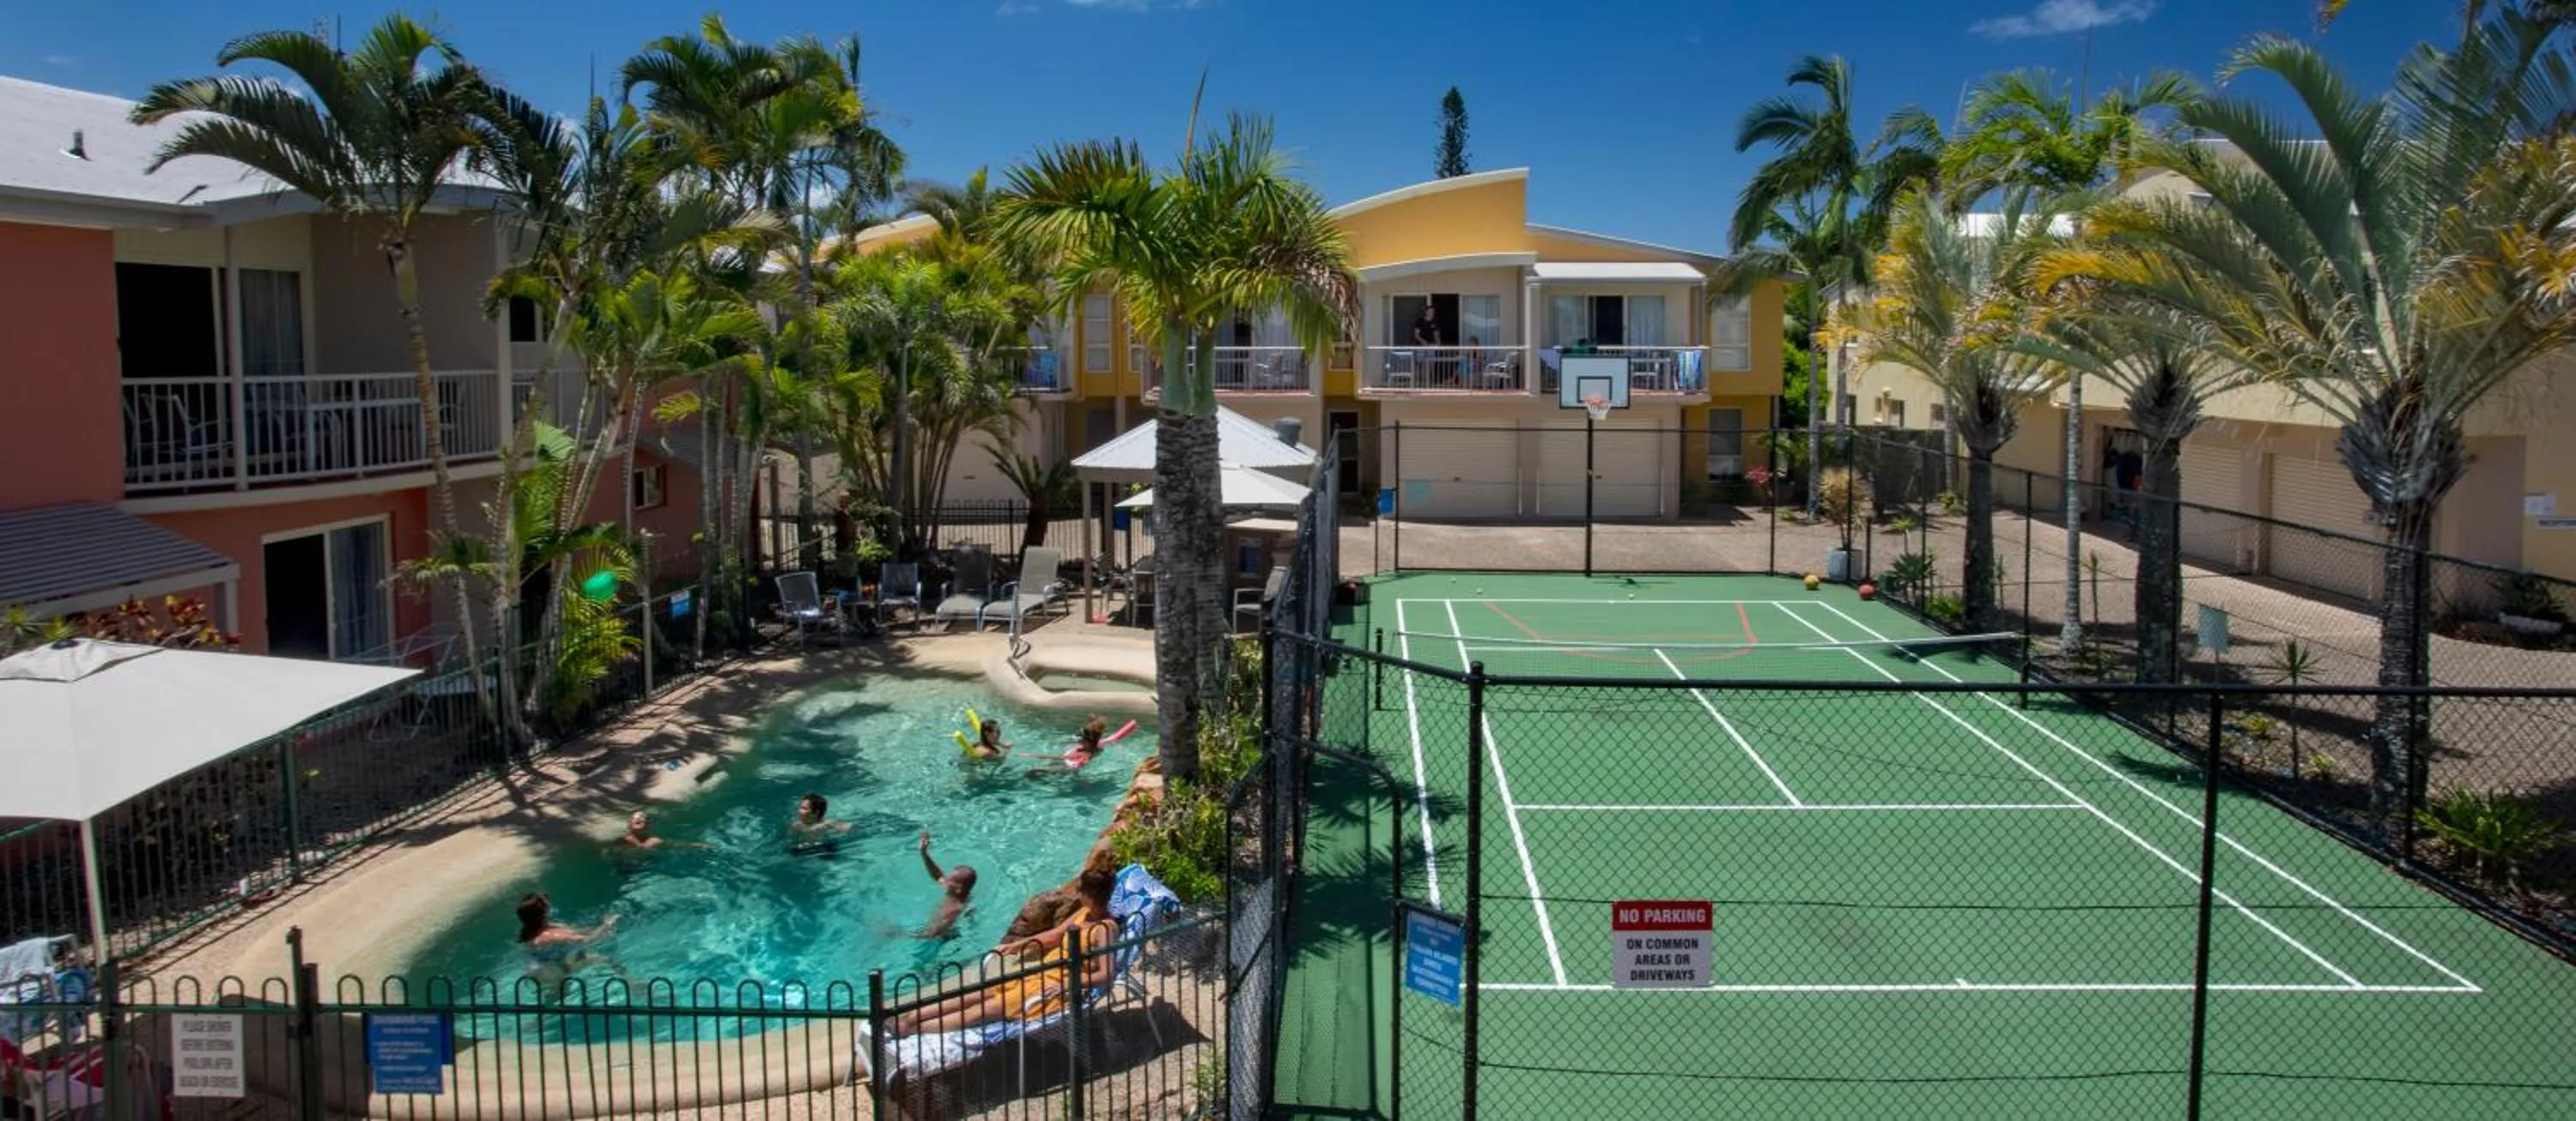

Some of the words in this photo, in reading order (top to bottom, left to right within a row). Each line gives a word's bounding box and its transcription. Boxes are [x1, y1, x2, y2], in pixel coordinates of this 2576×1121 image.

[1619, 908, 1639, 923] NO
[1644, 908, 1706, 924] PARKING
[1626, 938, 1643, 949] ON
[1646, 938, 1699, 949] COMMON
[1635, 954, 1671, 965] AREAS
[1675, 954, 1691, 965] OR
[1631, 969, 1695, 981] DRIVEWAYS
